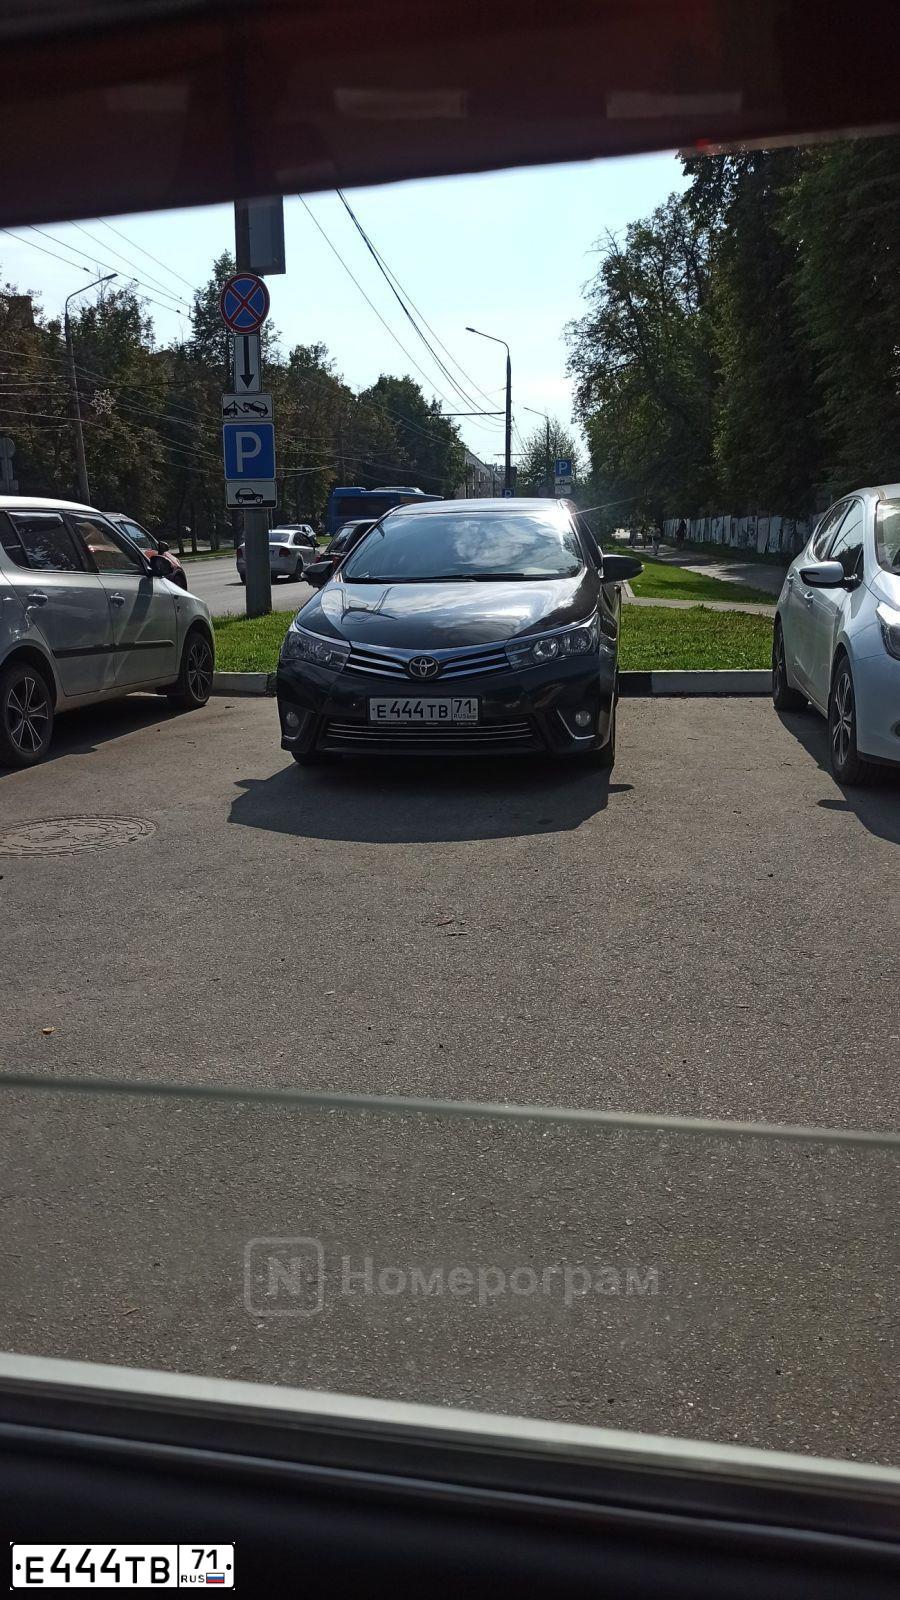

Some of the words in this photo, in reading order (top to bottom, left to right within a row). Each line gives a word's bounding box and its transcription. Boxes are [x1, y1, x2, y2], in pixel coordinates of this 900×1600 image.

[235, 431, 262, 473] P
[558, 461, 568, 475] P
[377, 700, 449, 719] Е444ТВ
[453, 699, 472, 714] 71
